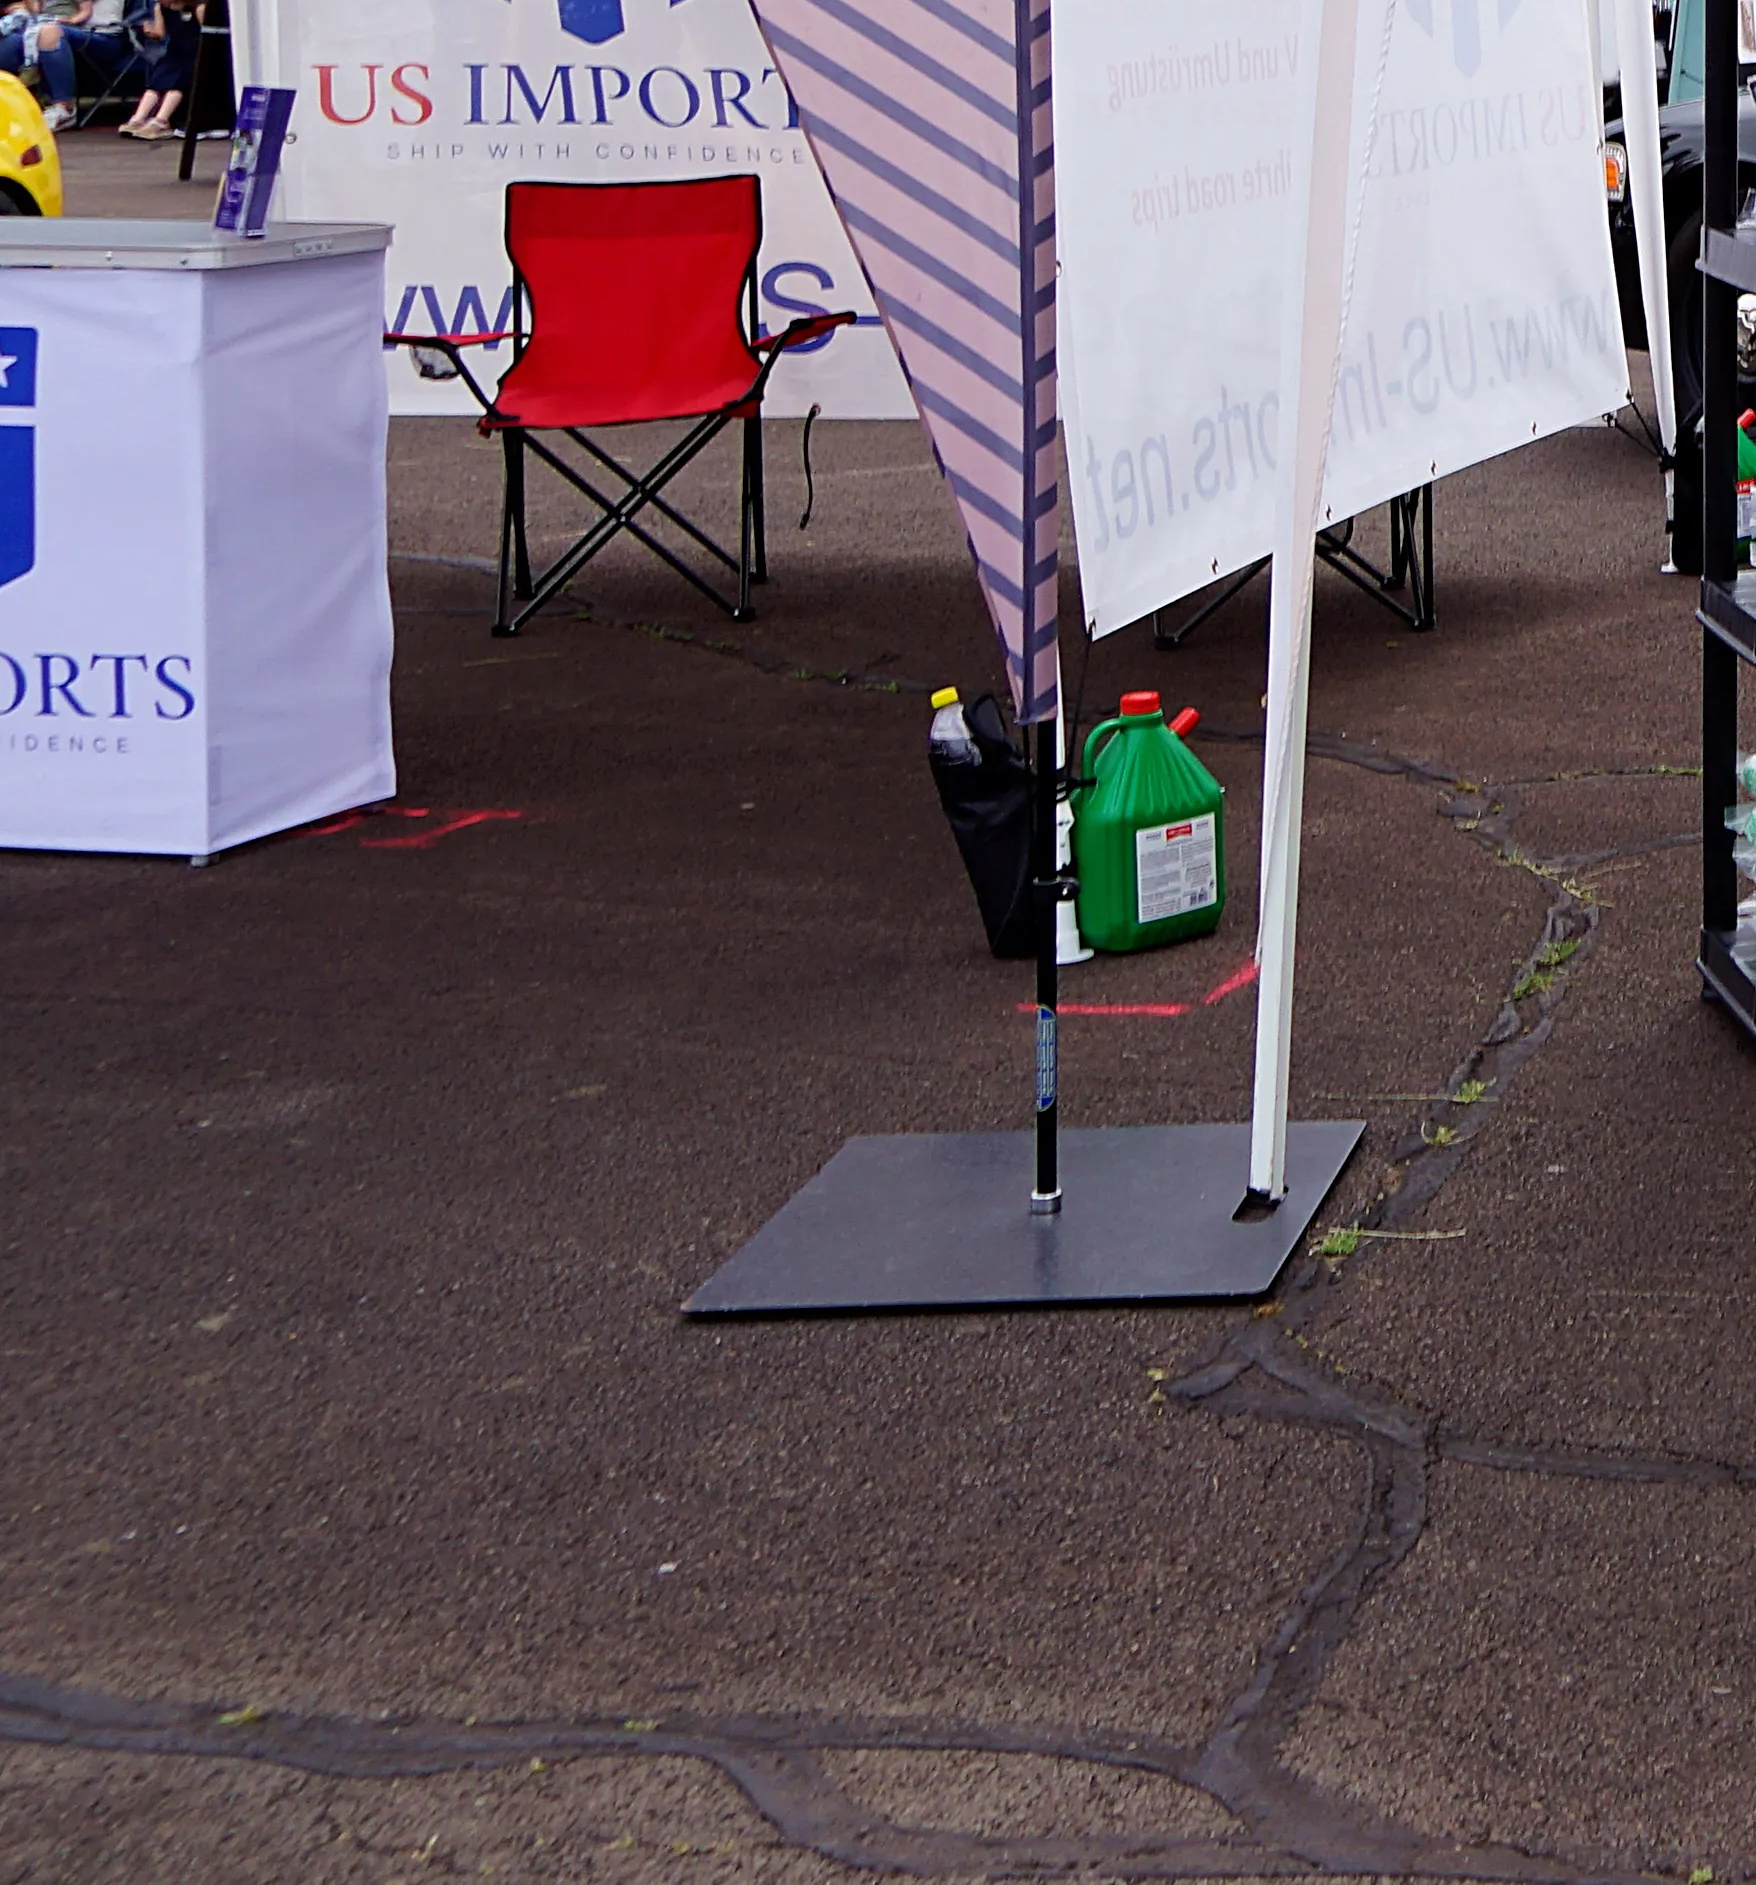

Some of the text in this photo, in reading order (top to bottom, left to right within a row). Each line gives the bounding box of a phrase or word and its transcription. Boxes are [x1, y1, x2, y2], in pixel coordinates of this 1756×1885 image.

[312, 62, 800, 129] US IMPORT
[387, 142, 805, 166] SHIP WITH CONFIDENCE
[10, 733, 131, 754] IDENCE
